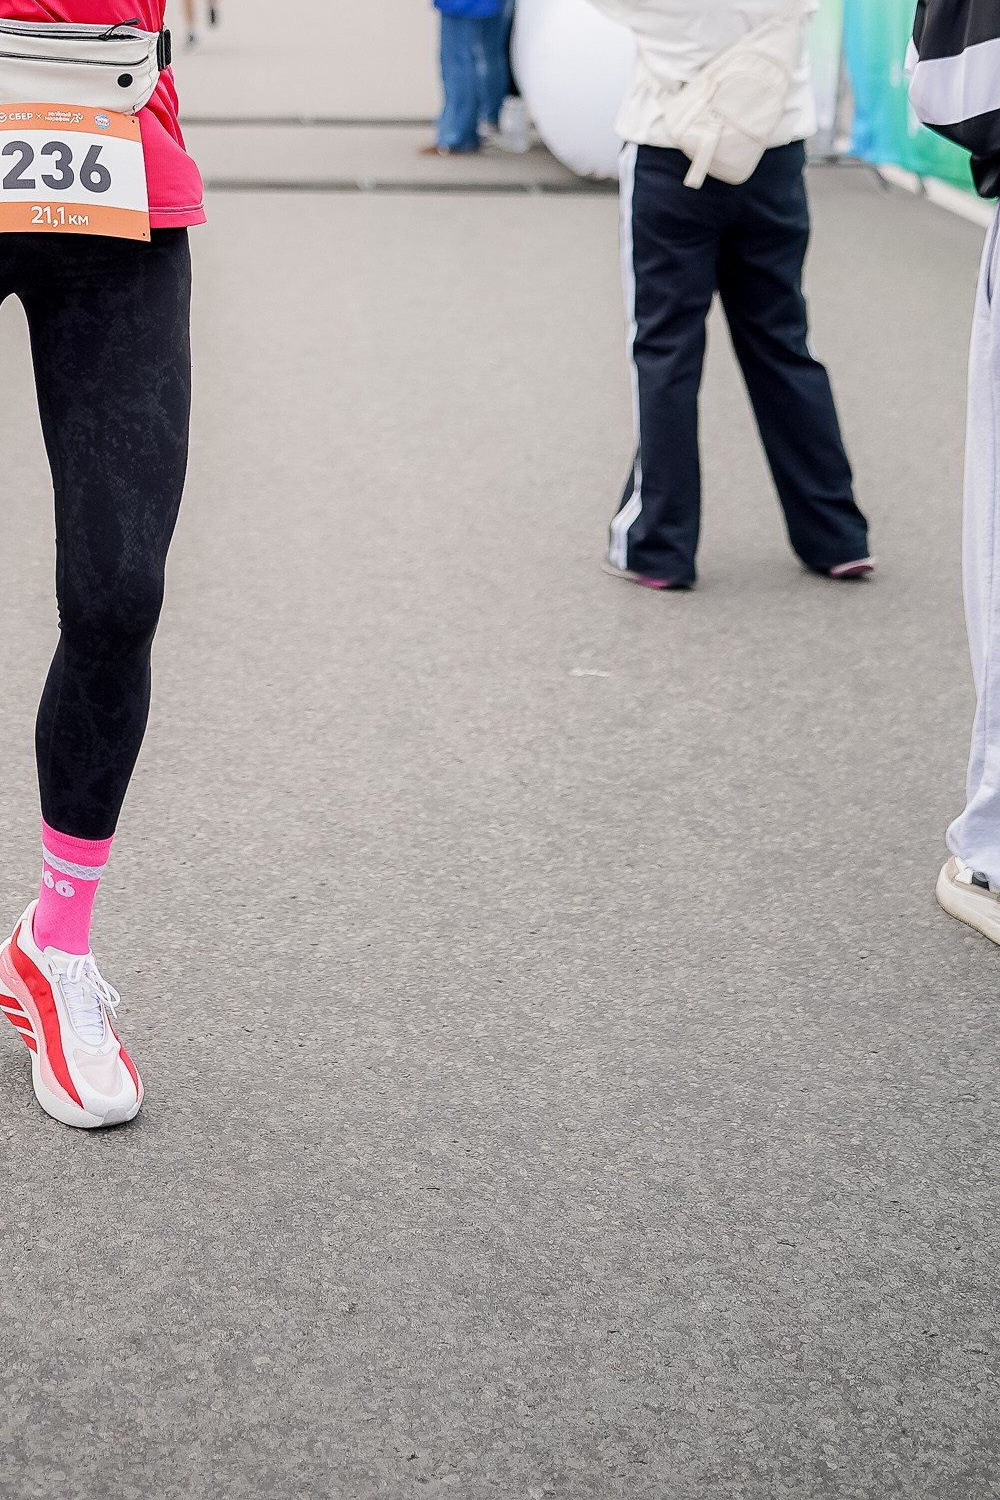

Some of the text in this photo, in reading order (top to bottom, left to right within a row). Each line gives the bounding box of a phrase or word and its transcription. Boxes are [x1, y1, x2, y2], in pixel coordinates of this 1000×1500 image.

[9, 112, 33, 121] СБЕР
[2, 141, 111, 193] 236
[31, 205, 66, 228] 21,1
